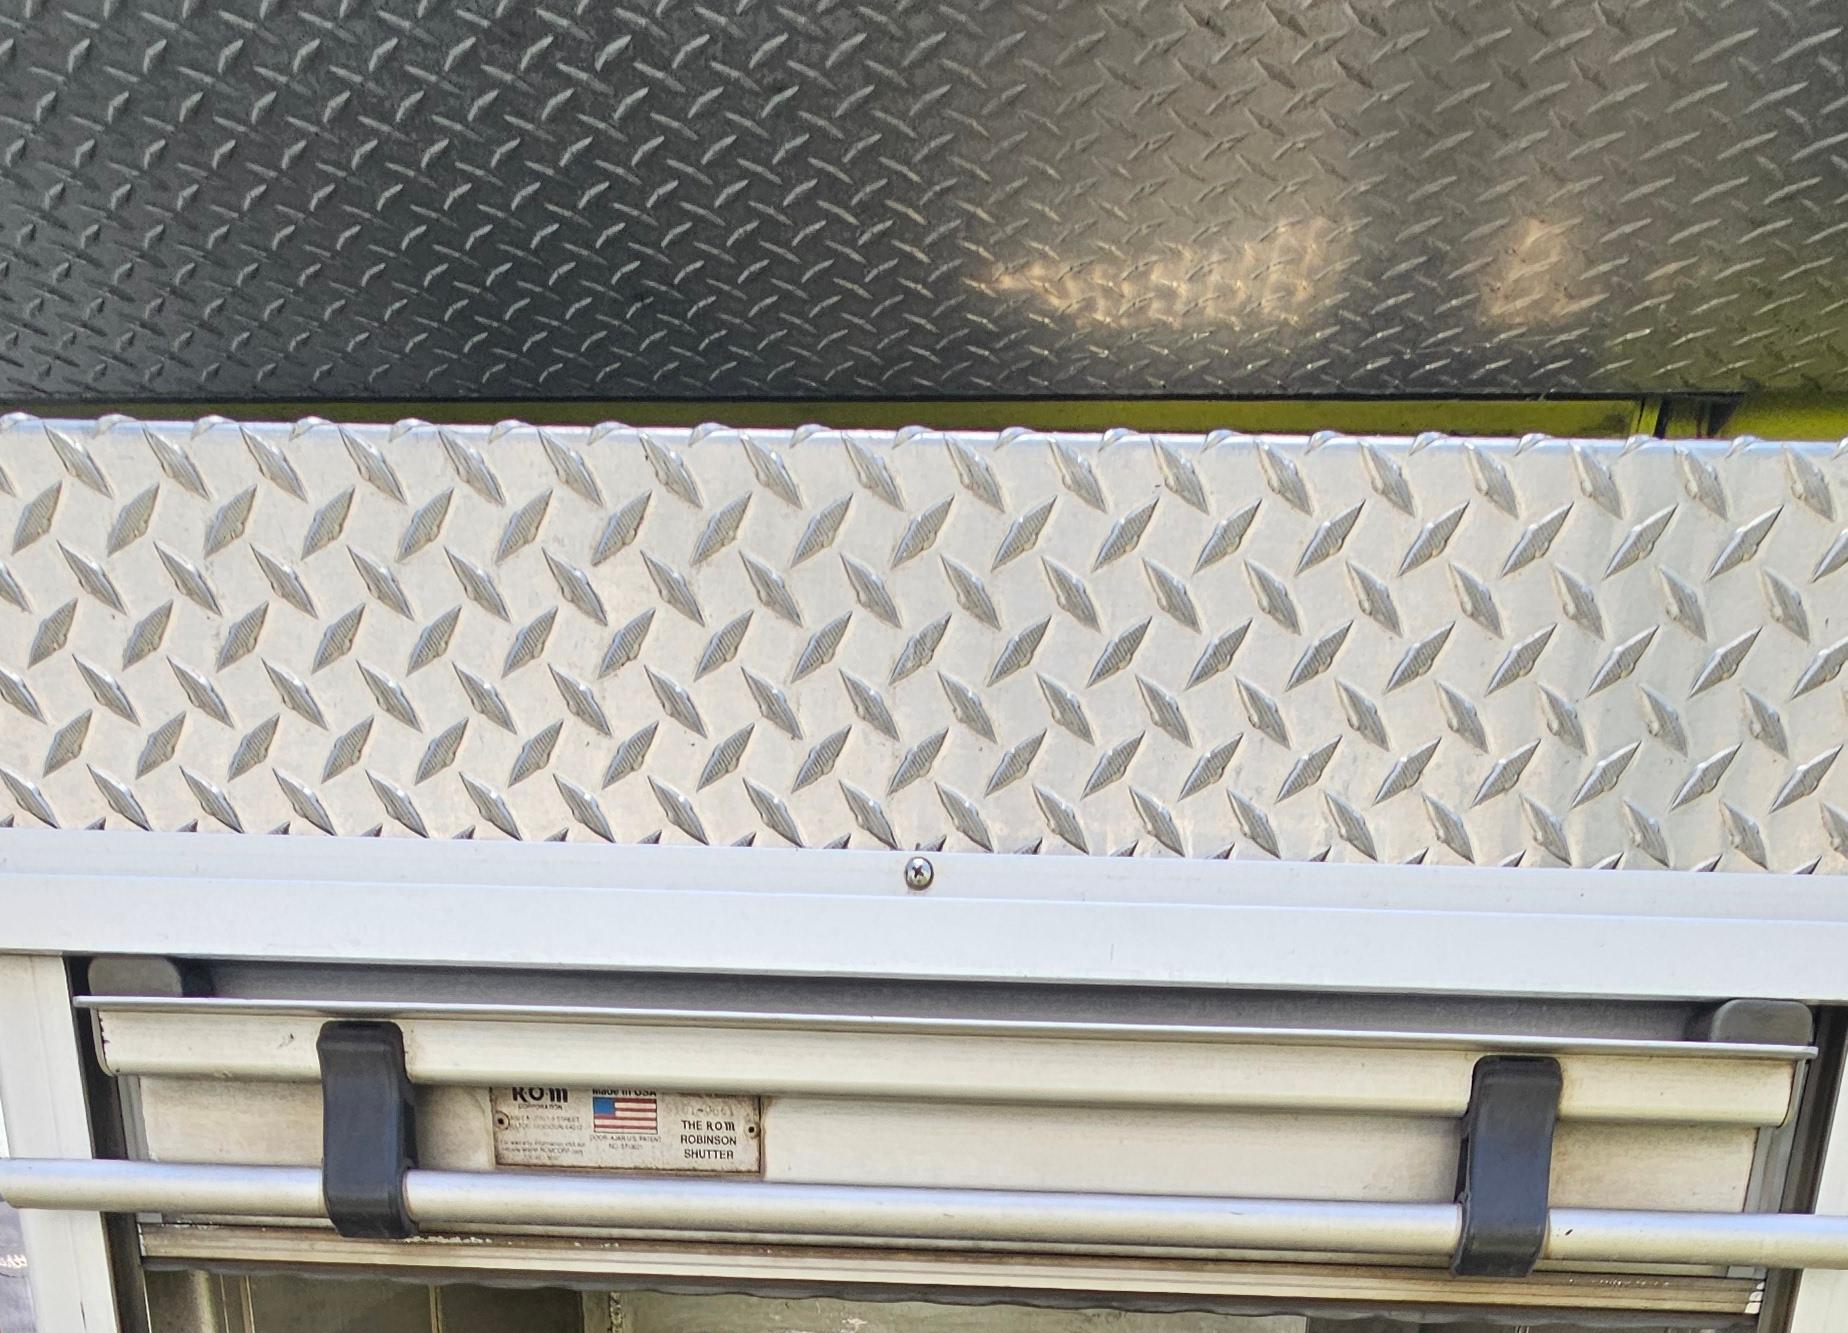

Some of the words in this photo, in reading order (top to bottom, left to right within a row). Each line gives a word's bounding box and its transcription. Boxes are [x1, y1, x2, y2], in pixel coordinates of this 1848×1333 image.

[681, 1120, 702, 1130] THE
[680, 1134, 737, 1146] ROBINSON
[684, 1148, 734, 1160] SHUTTER
